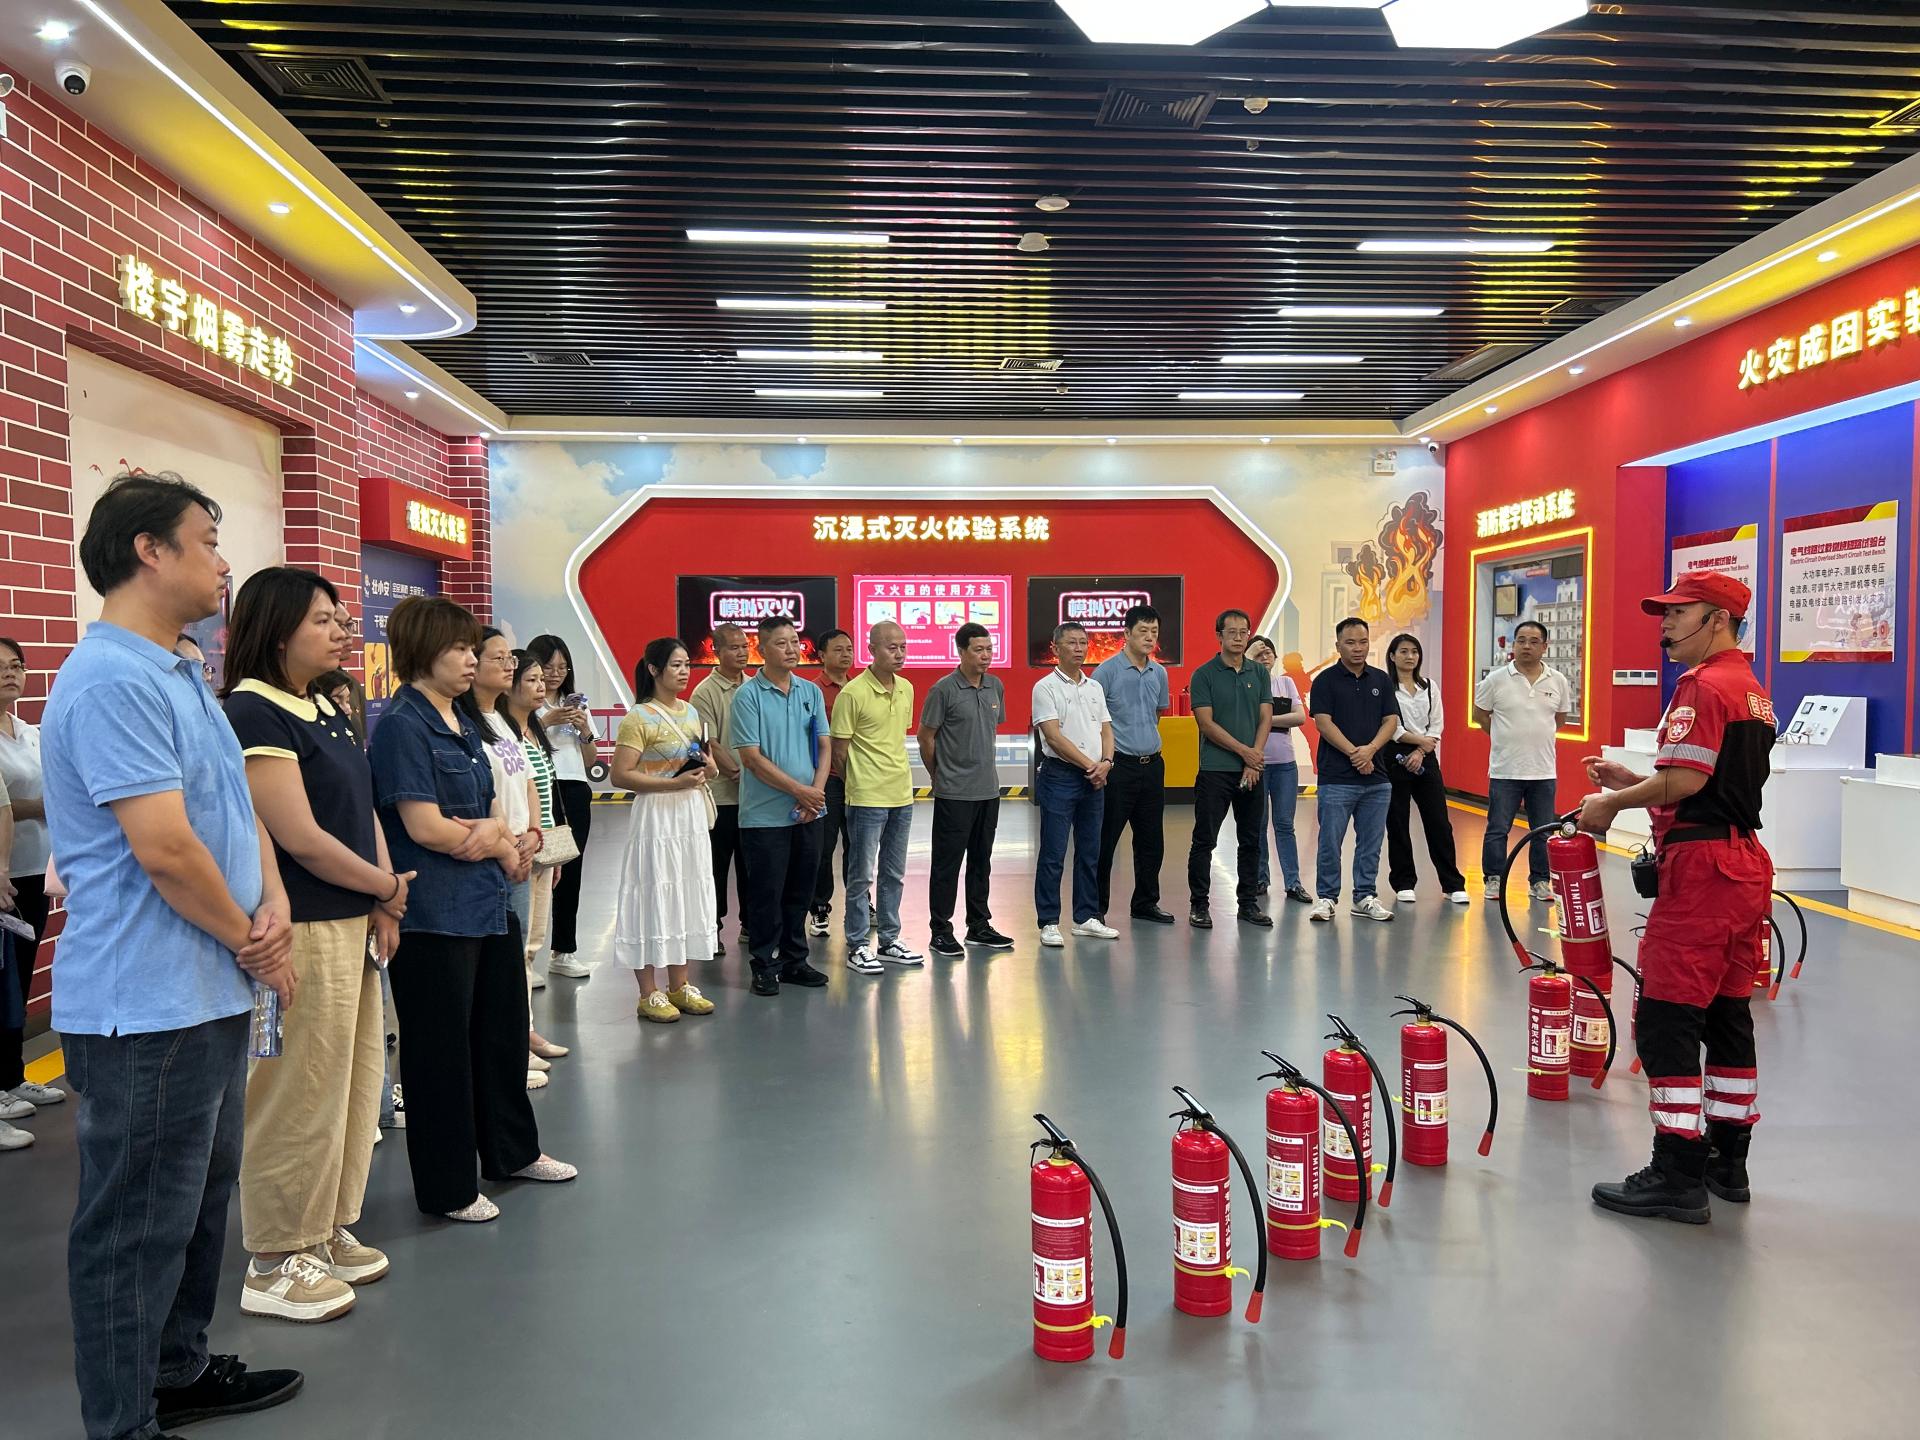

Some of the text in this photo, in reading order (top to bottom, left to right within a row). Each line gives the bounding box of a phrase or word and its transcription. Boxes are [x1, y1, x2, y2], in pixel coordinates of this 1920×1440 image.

[118, 255, 293, 386] 楼宇烟雾走势
[406, 500, 467, 545] 模拟灭火体验
[812, 515, 1050, 543] 沉浸式灭火体验系统
[1818, 554, 1836, 562] Overload
[1836, 552, 1848, 560] Short
[1848, 551, 1862, 559] Circuit
[1862, 549, 1871, 557] Test
[1872, 548, 1886, 556] Bench
[873, 584, 992, 596] 灭火器的使用方法
[719, 598, 795, 618] 模拟灭火
[1570, 882, 1585, 927] TIMIFIRE
